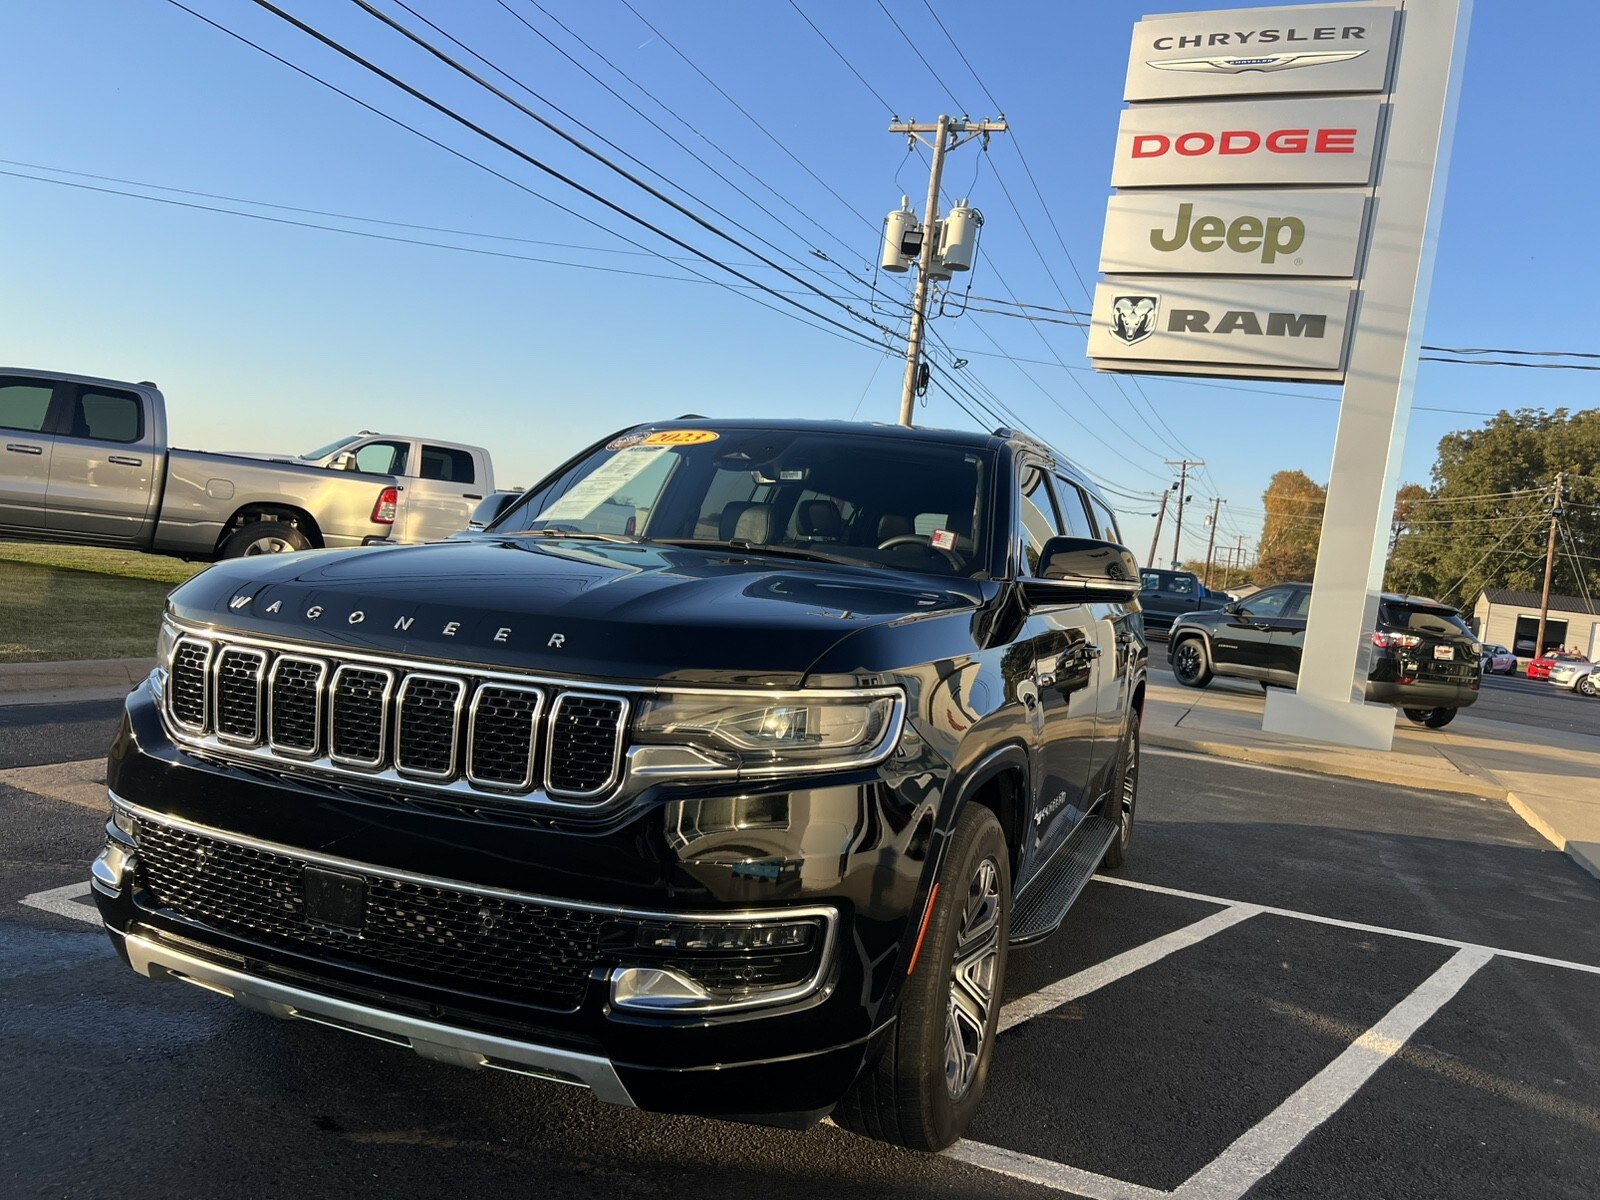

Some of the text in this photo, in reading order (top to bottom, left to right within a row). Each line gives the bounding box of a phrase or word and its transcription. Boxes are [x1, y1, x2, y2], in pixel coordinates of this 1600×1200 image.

[1153, 27, 1366, 50] CHRYSLER
[1131, 129, 1358, 159] DODGE
[1150, 203, 1306, 264] Jeep
[1167, 309, 1327, 339] RAM
[645, 433, 706, 442] 2023
[229, 595, 567, 649] WAGONEER
